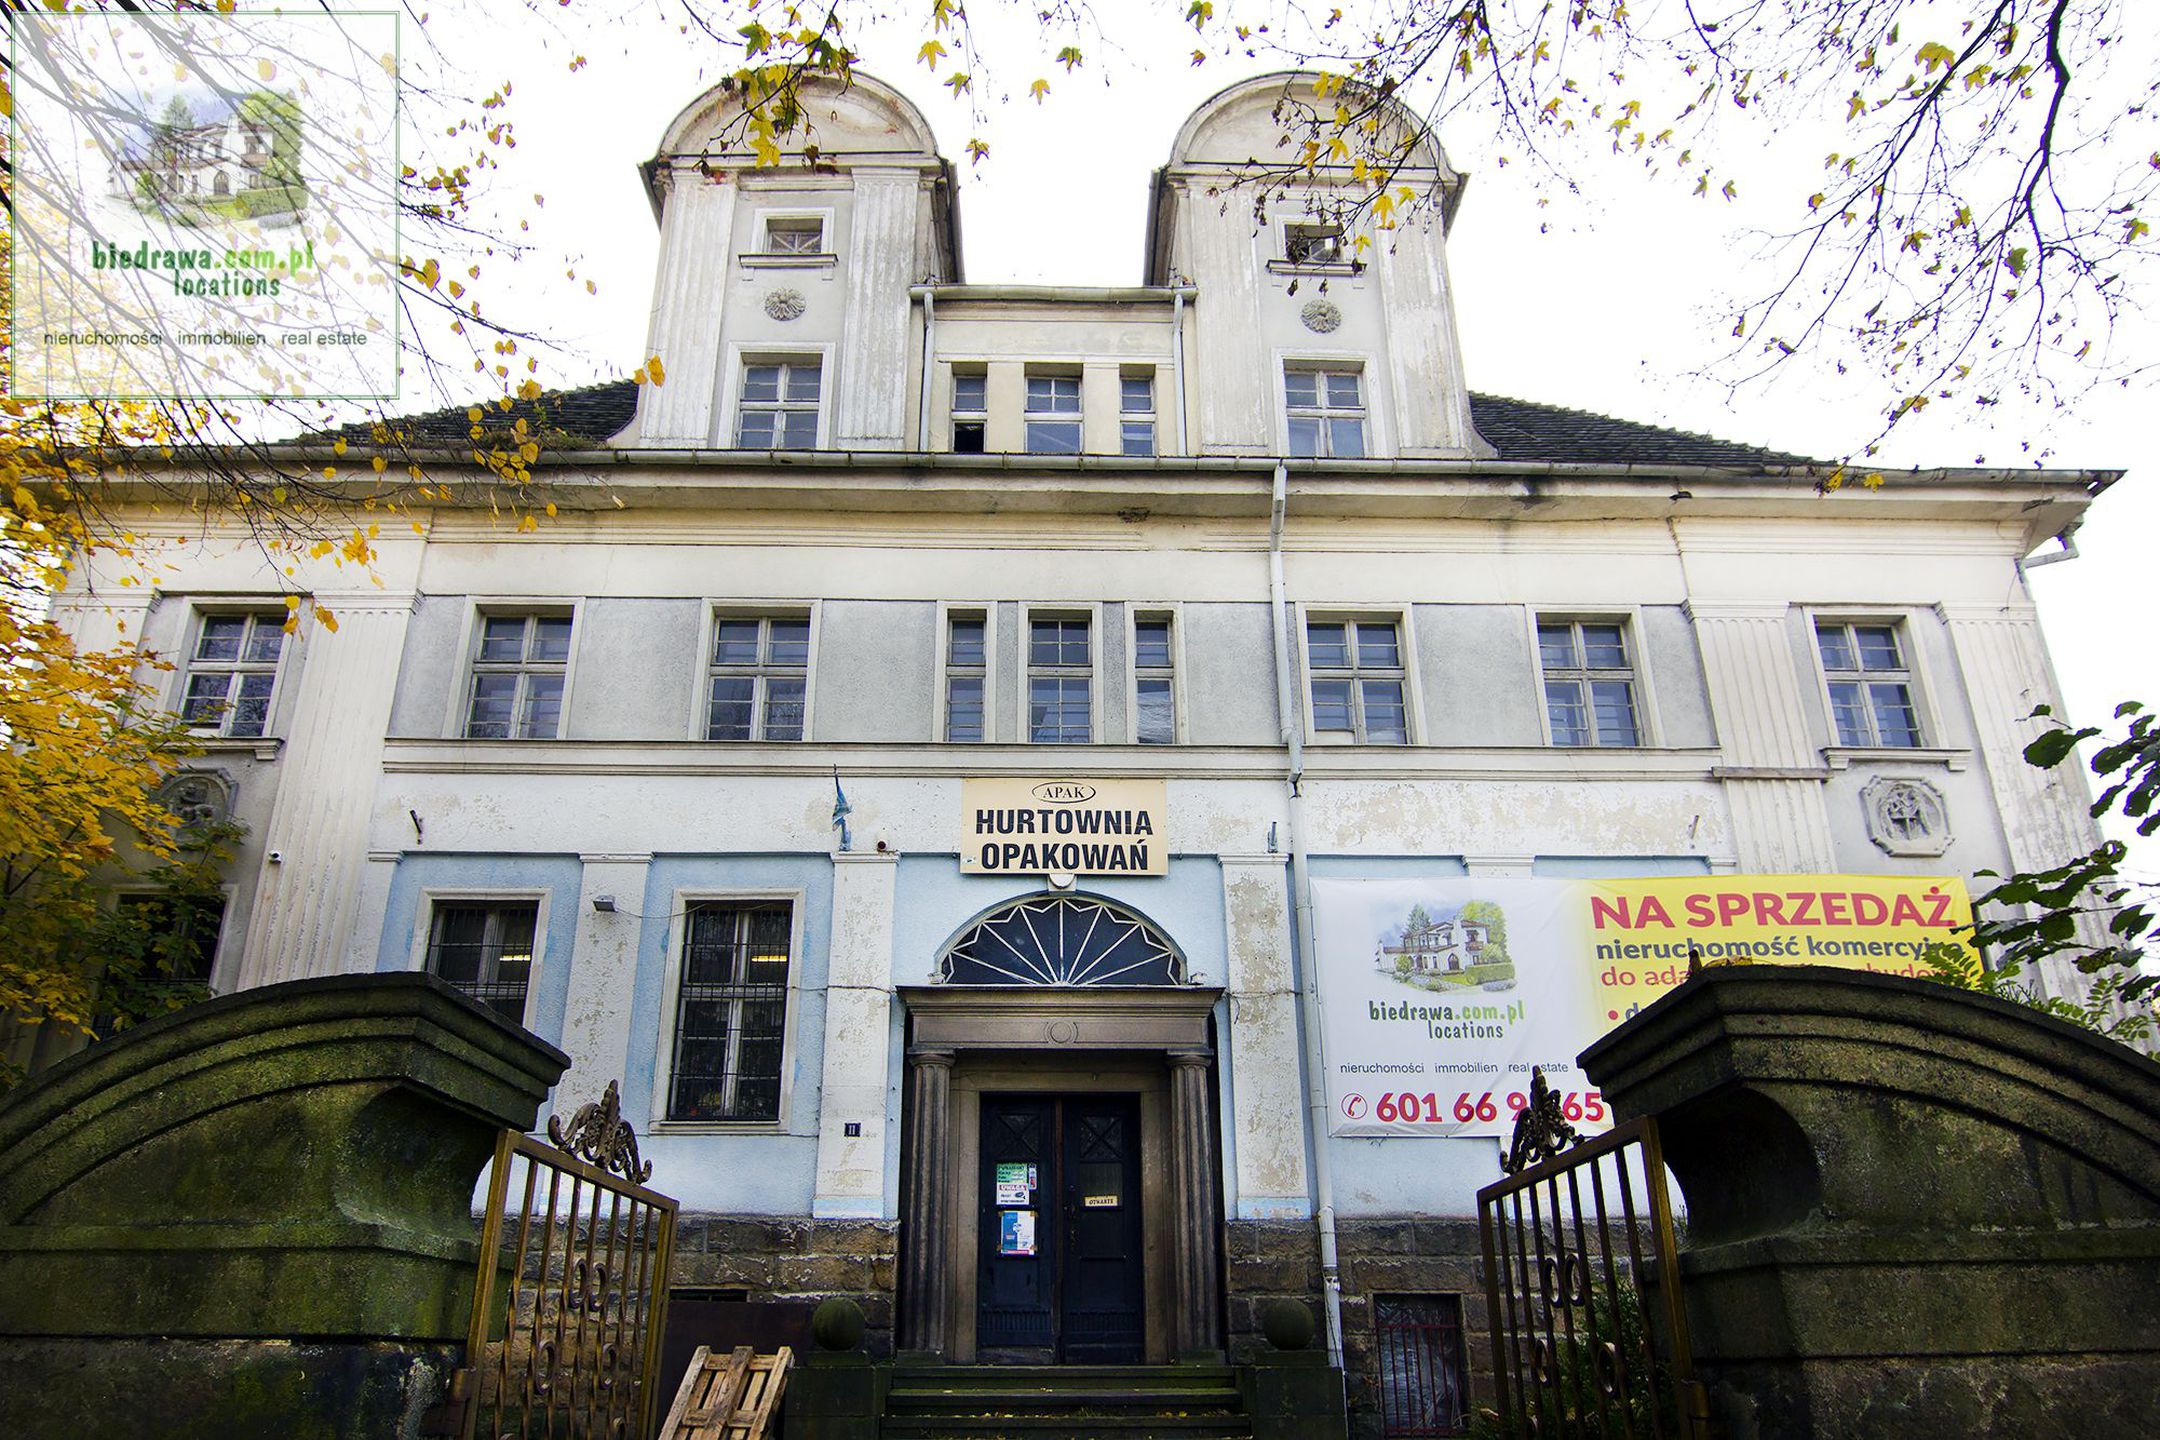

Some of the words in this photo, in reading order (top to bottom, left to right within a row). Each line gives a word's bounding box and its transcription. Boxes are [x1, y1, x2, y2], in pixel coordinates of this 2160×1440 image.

[1044, 786, 1085, 798] APAK
[975, 809, 1153, 835] HURTOWNIA
[981, 838, 1148, 871] OPAKOWAŃ
[1591, 896, 1675, 929] NA
[1684, 886, 1957, 927] SPRZEDAŻ
[1596, 936, 1800, 960] nieruchomość
[1601, 966, 1636, 986] do
[1368, 1000, 1525, 1025] biedrawa.com.pl
[1427, 1020, 1504, 1040] locations
[1340, 1062, 1425, 1074] nieruchomości
[1434, 1062, 1499, 1073] immobilien
[1508, 1063, 1530, 1073] real
[1538, 1063, 1569, 1073] state
[1376, 1092, 1443, 1123] 601
[1453, 1092, 1498, 1122] 66
[1562, 1092, 1604, 1122] 65
